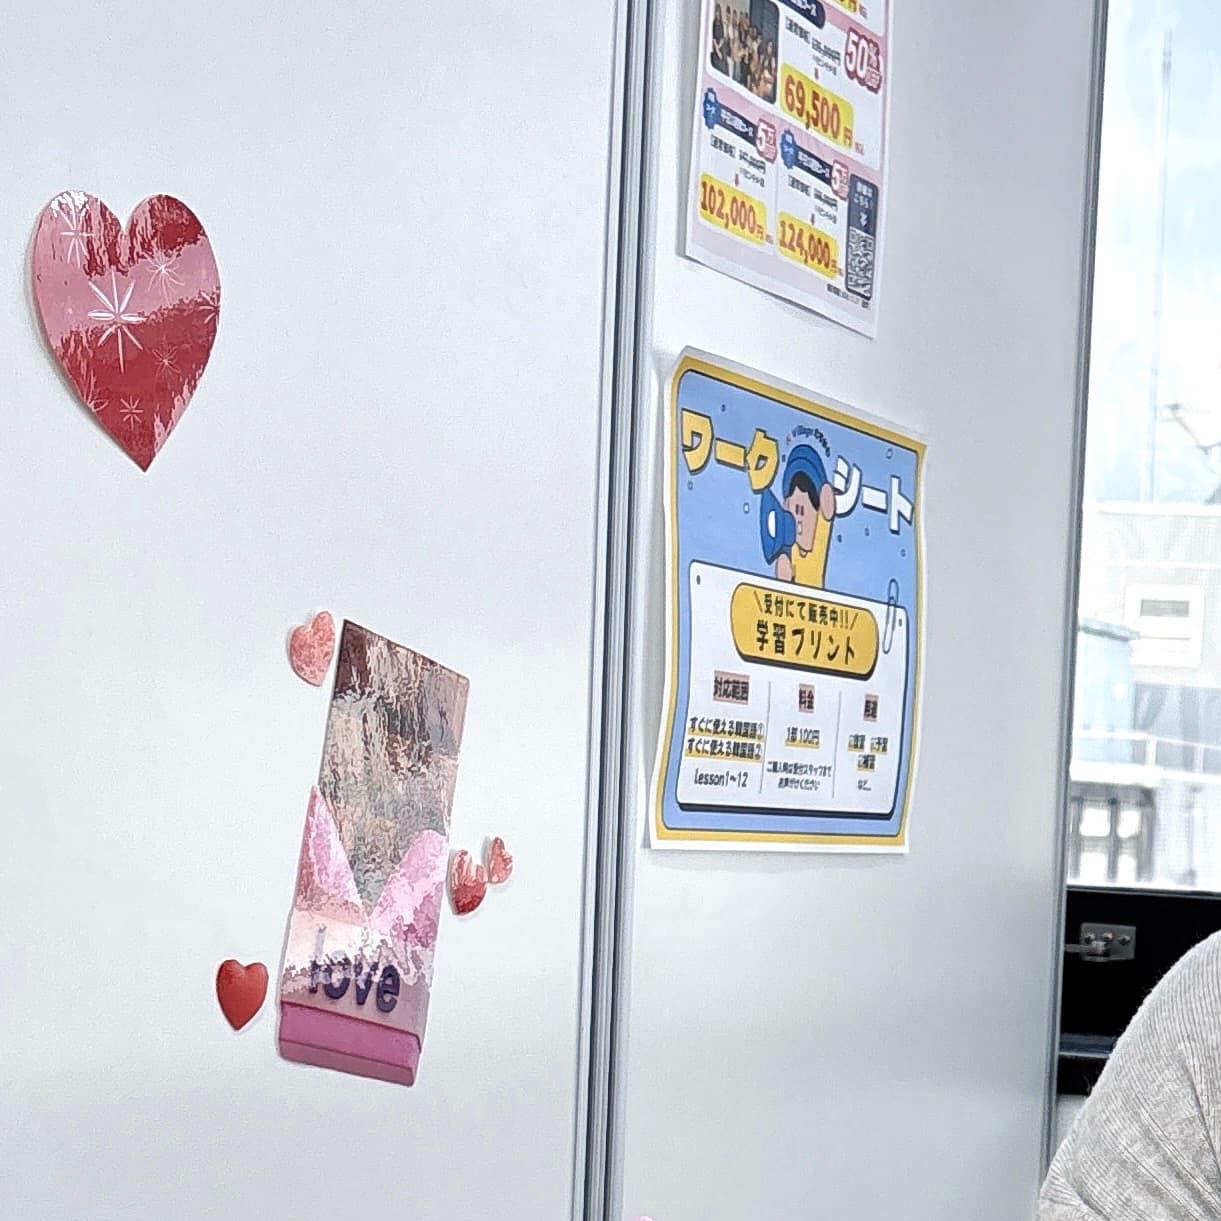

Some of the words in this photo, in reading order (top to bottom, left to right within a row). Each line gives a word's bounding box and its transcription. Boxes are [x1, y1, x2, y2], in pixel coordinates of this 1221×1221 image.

[681, 407, 779, 494] ワーク
[833, 456, 914, 535] シート
[756, 620, 855, 665] 学習プリント
[713, 677, 750, 702] 対応範囲
